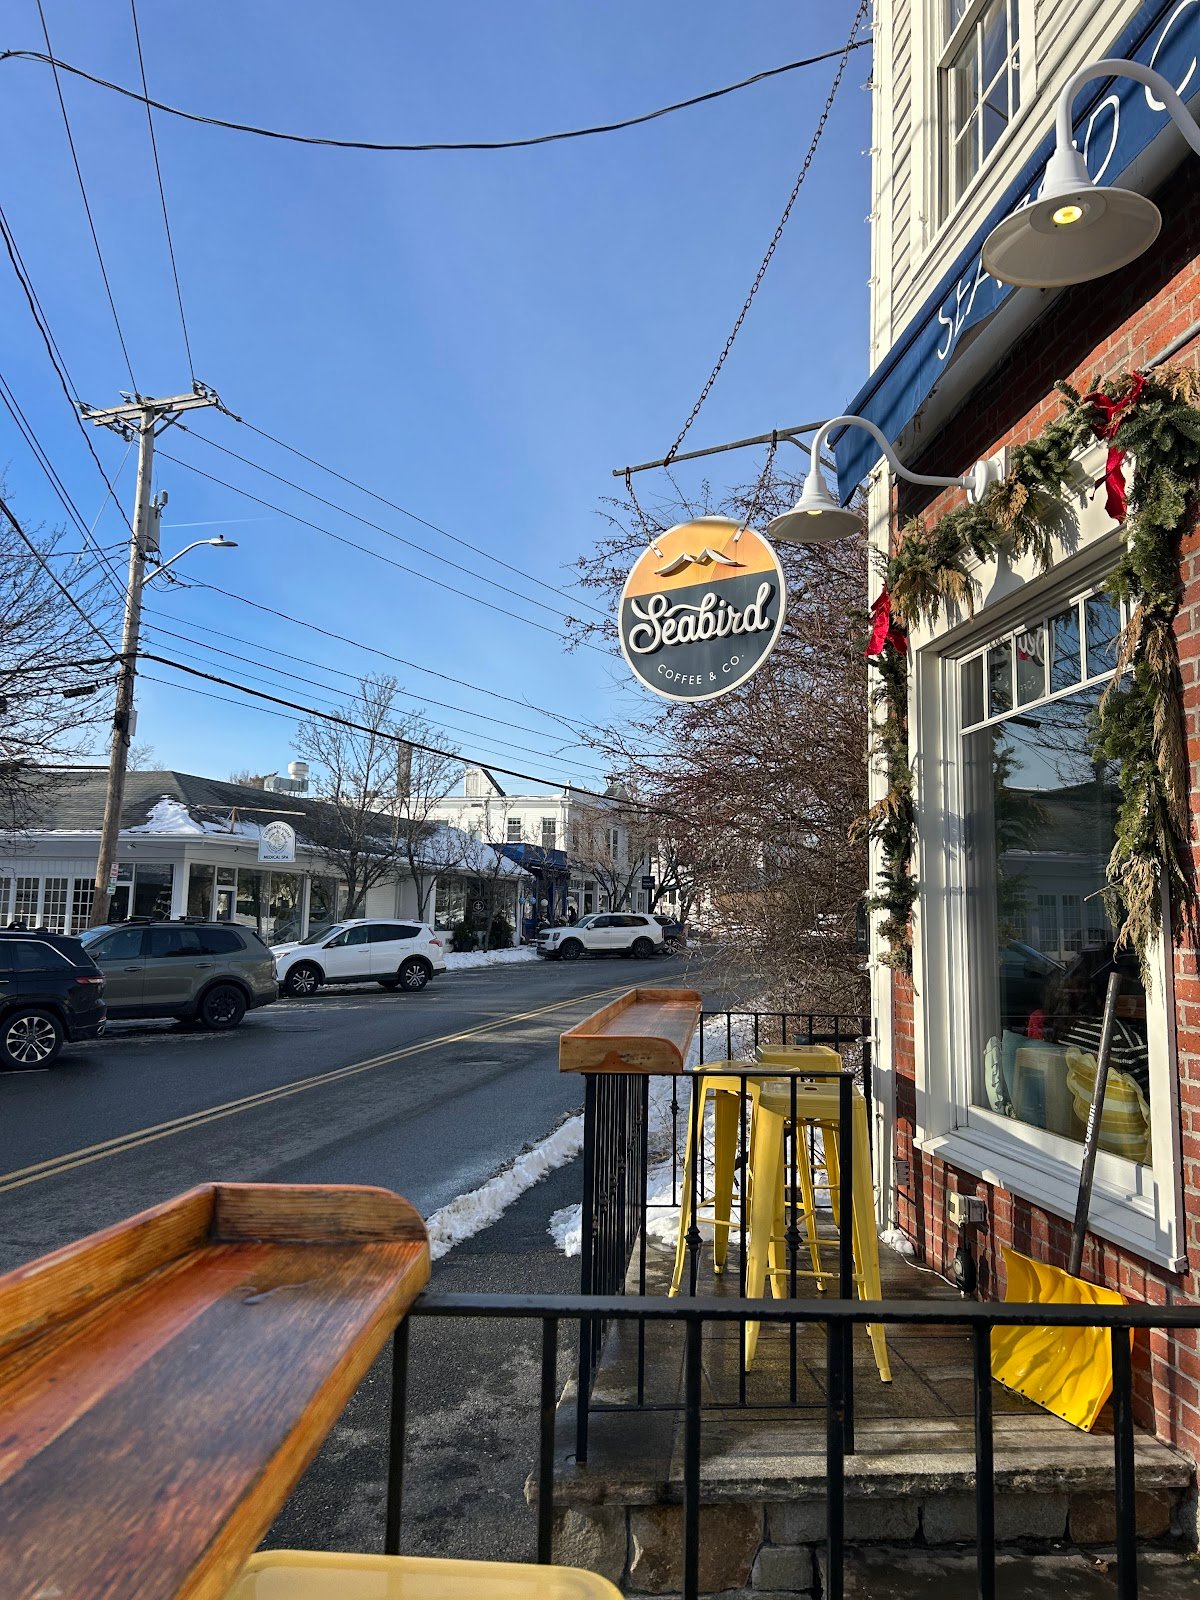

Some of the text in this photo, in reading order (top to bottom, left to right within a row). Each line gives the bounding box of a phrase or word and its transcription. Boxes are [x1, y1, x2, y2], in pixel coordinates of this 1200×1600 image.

[628, 581, 772, 654] Seabird
[657, 663, 702, 685] COFFEE
[708, 671, 717, 682] &
